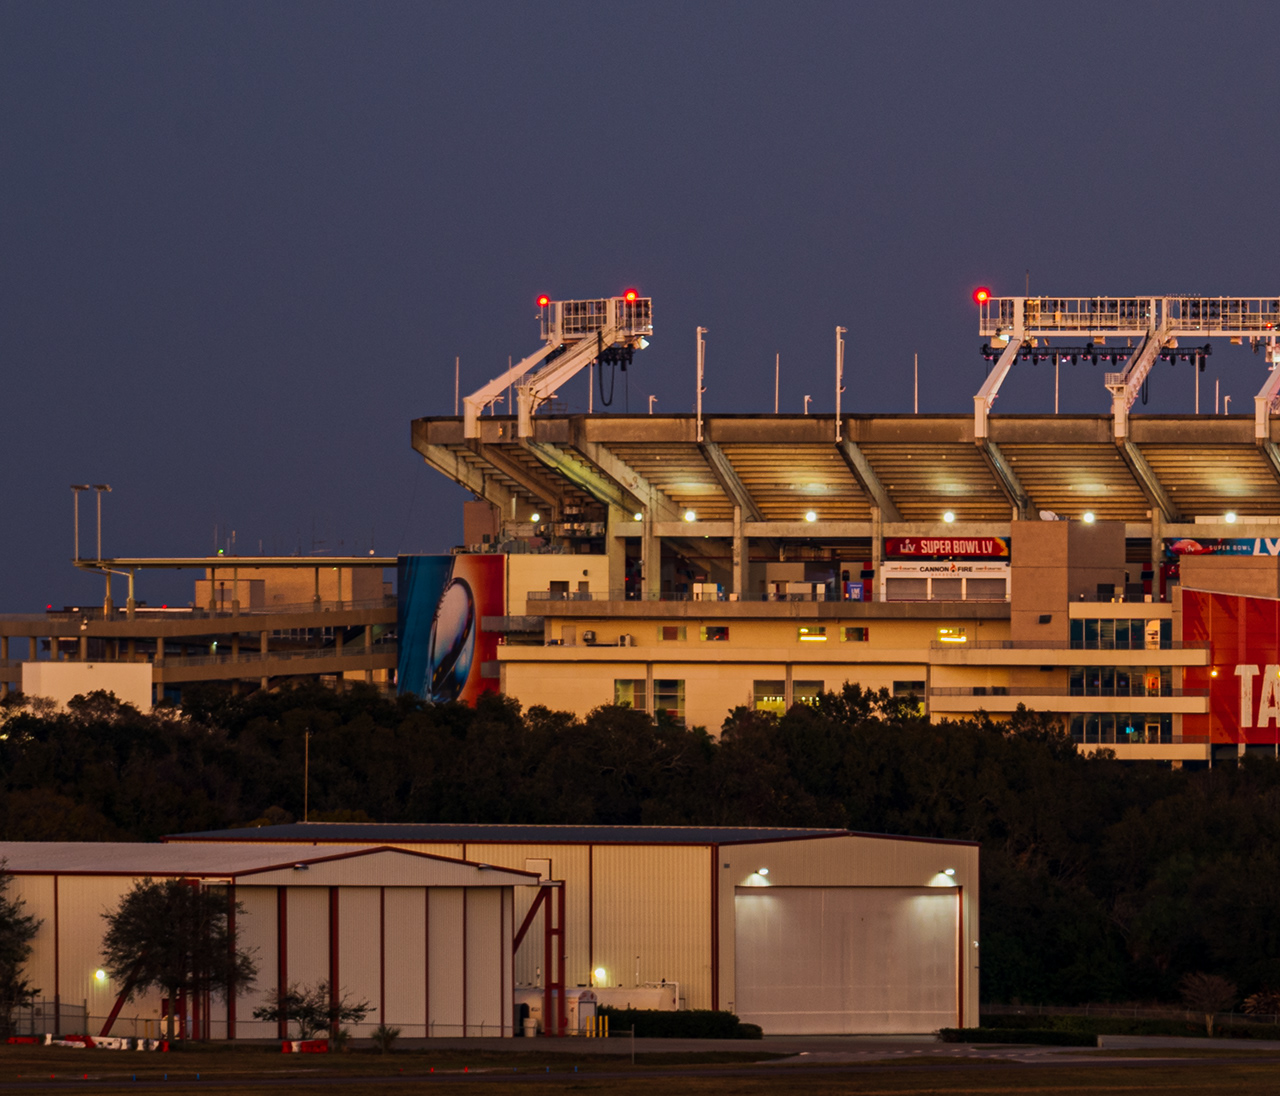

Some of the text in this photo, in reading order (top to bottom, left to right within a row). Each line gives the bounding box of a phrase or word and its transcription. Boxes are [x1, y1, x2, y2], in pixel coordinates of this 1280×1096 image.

[921, 540, 993, 554] SUPER BOWL LV
